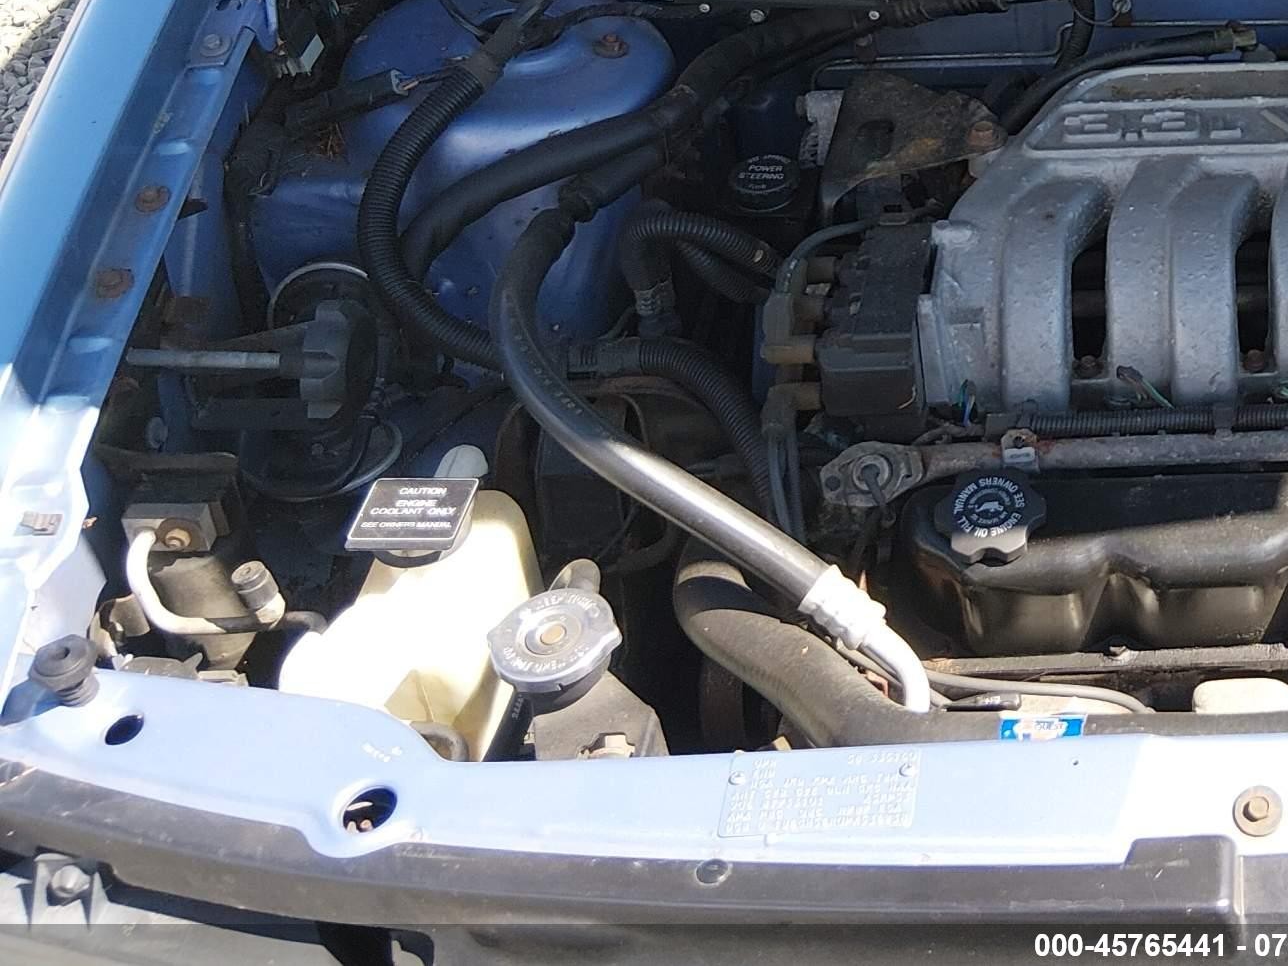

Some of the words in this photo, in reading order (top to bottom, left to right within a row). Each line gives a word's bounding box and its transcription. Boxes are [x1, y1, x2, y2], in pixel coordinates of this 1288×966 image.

[748, 164, 784, 172] POWER
[738, 172, 785, 180] STEERING
[399, 487, 448, 495] CAUTION
[395, 499, 438, 507] ENGINE
[953, 483, 978, 515] MANUAL
[1014, 493, 1026, 509] SEE
[369, 507, 423, 515] COOLANT
[427, 507, 457, 515] ONLY
[957, 516, 975, 534] FILL
[990, 512, 1022, 537] ENGINE
[974, 527, 988, 539] OIL
